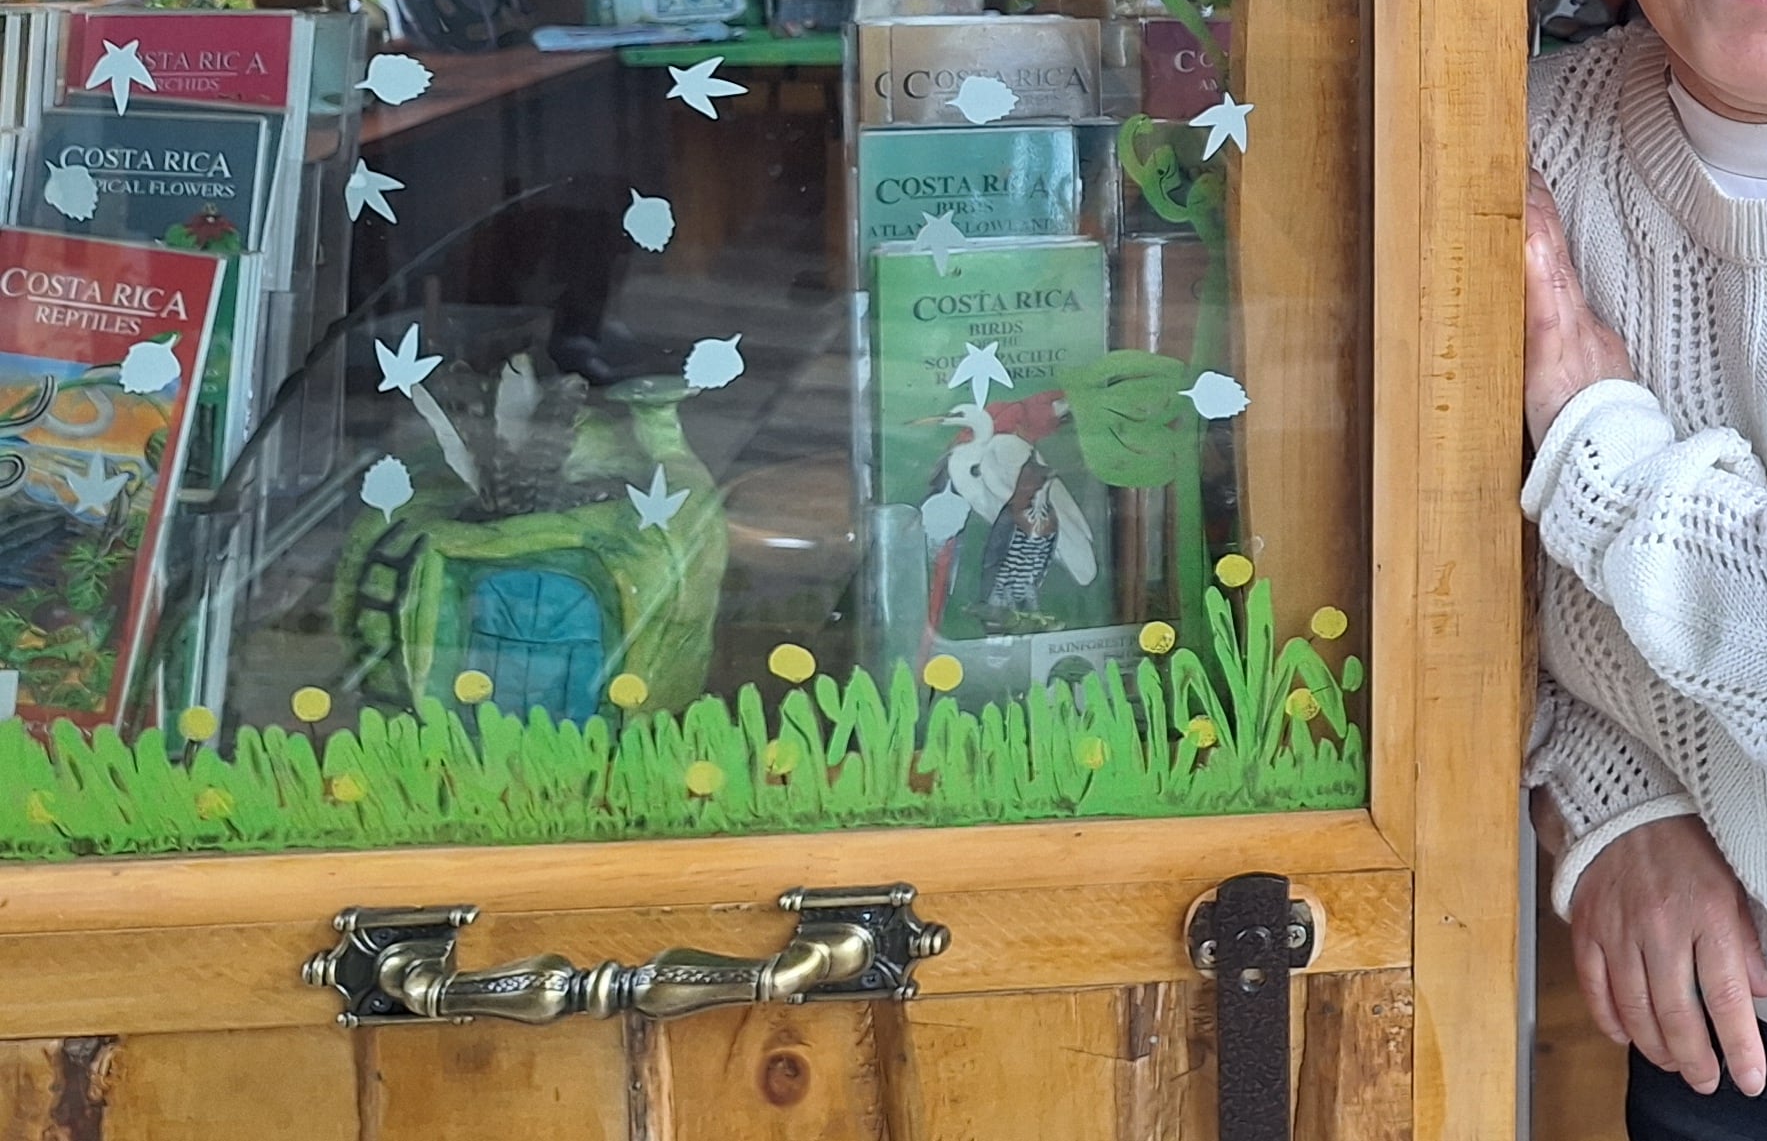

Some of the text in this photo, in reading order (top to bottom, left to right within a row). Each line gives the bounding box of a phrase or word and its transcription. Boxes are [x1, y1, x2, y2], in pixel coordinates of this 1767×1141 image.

[138, 51, 270, 76] STA RICA
[1016, 67, 1090, 94] RICA
[59, 145, 234, 179] COSTA RICA
[96, 178, 237, 199] PICAL FLOWERS
[876, 173, 1048, 206] COSTA RIA
[1, 266, 189, 322] COSTA RICA
[913, 288, 1083, 322] COSTA RICA
[34, 305, 142, 337] REPTILES
[969, 320, 1024, 337] BIRDS
